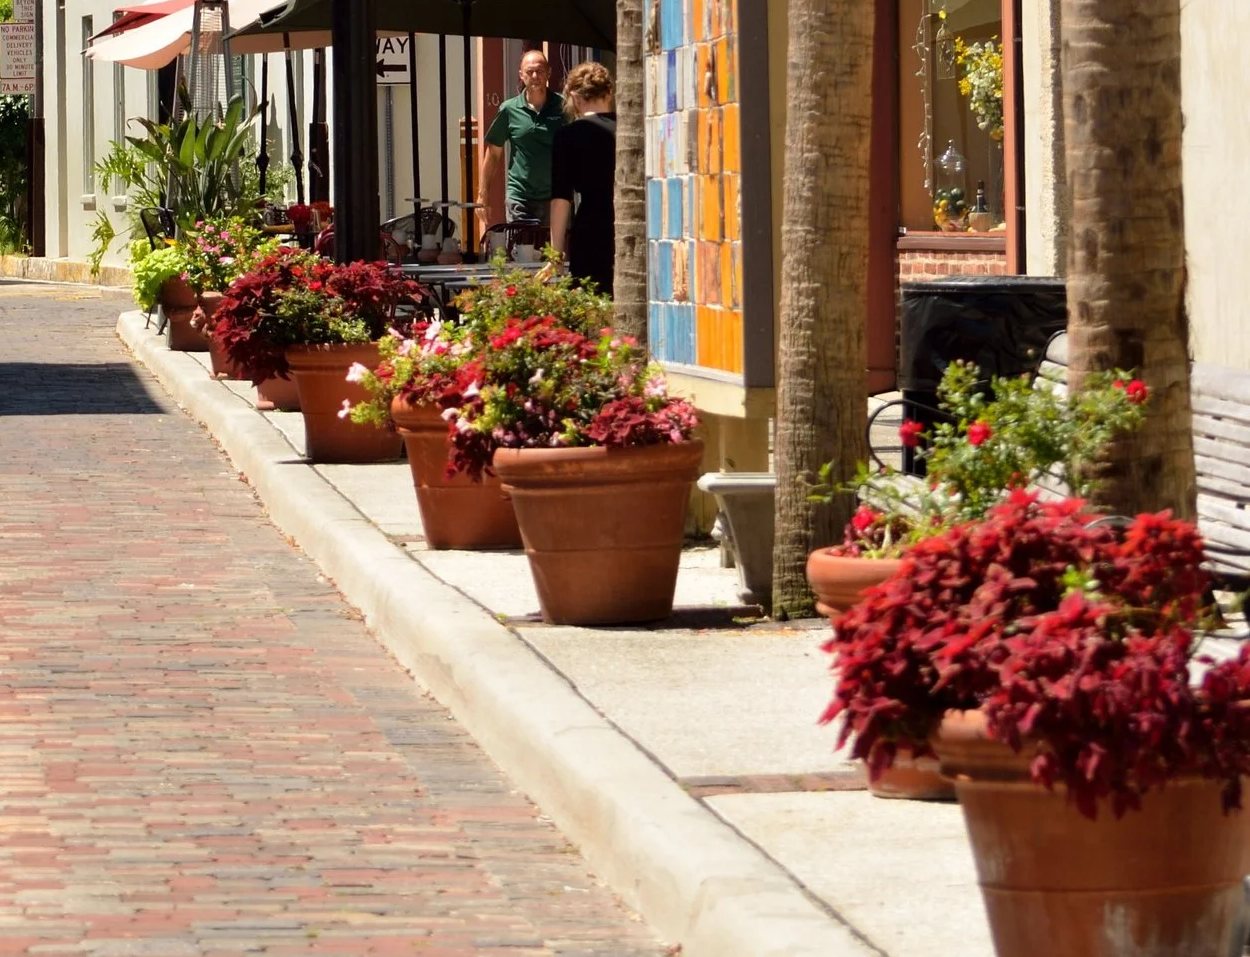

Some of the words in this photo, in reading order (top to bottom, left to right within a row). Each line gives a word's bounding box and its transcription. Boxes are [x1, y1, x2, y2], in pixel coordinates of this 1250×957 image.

[1, 25, 9, 33] NO
[12, 25, 34, 33] PARKIN
[377, 37, 410, 54] AY
